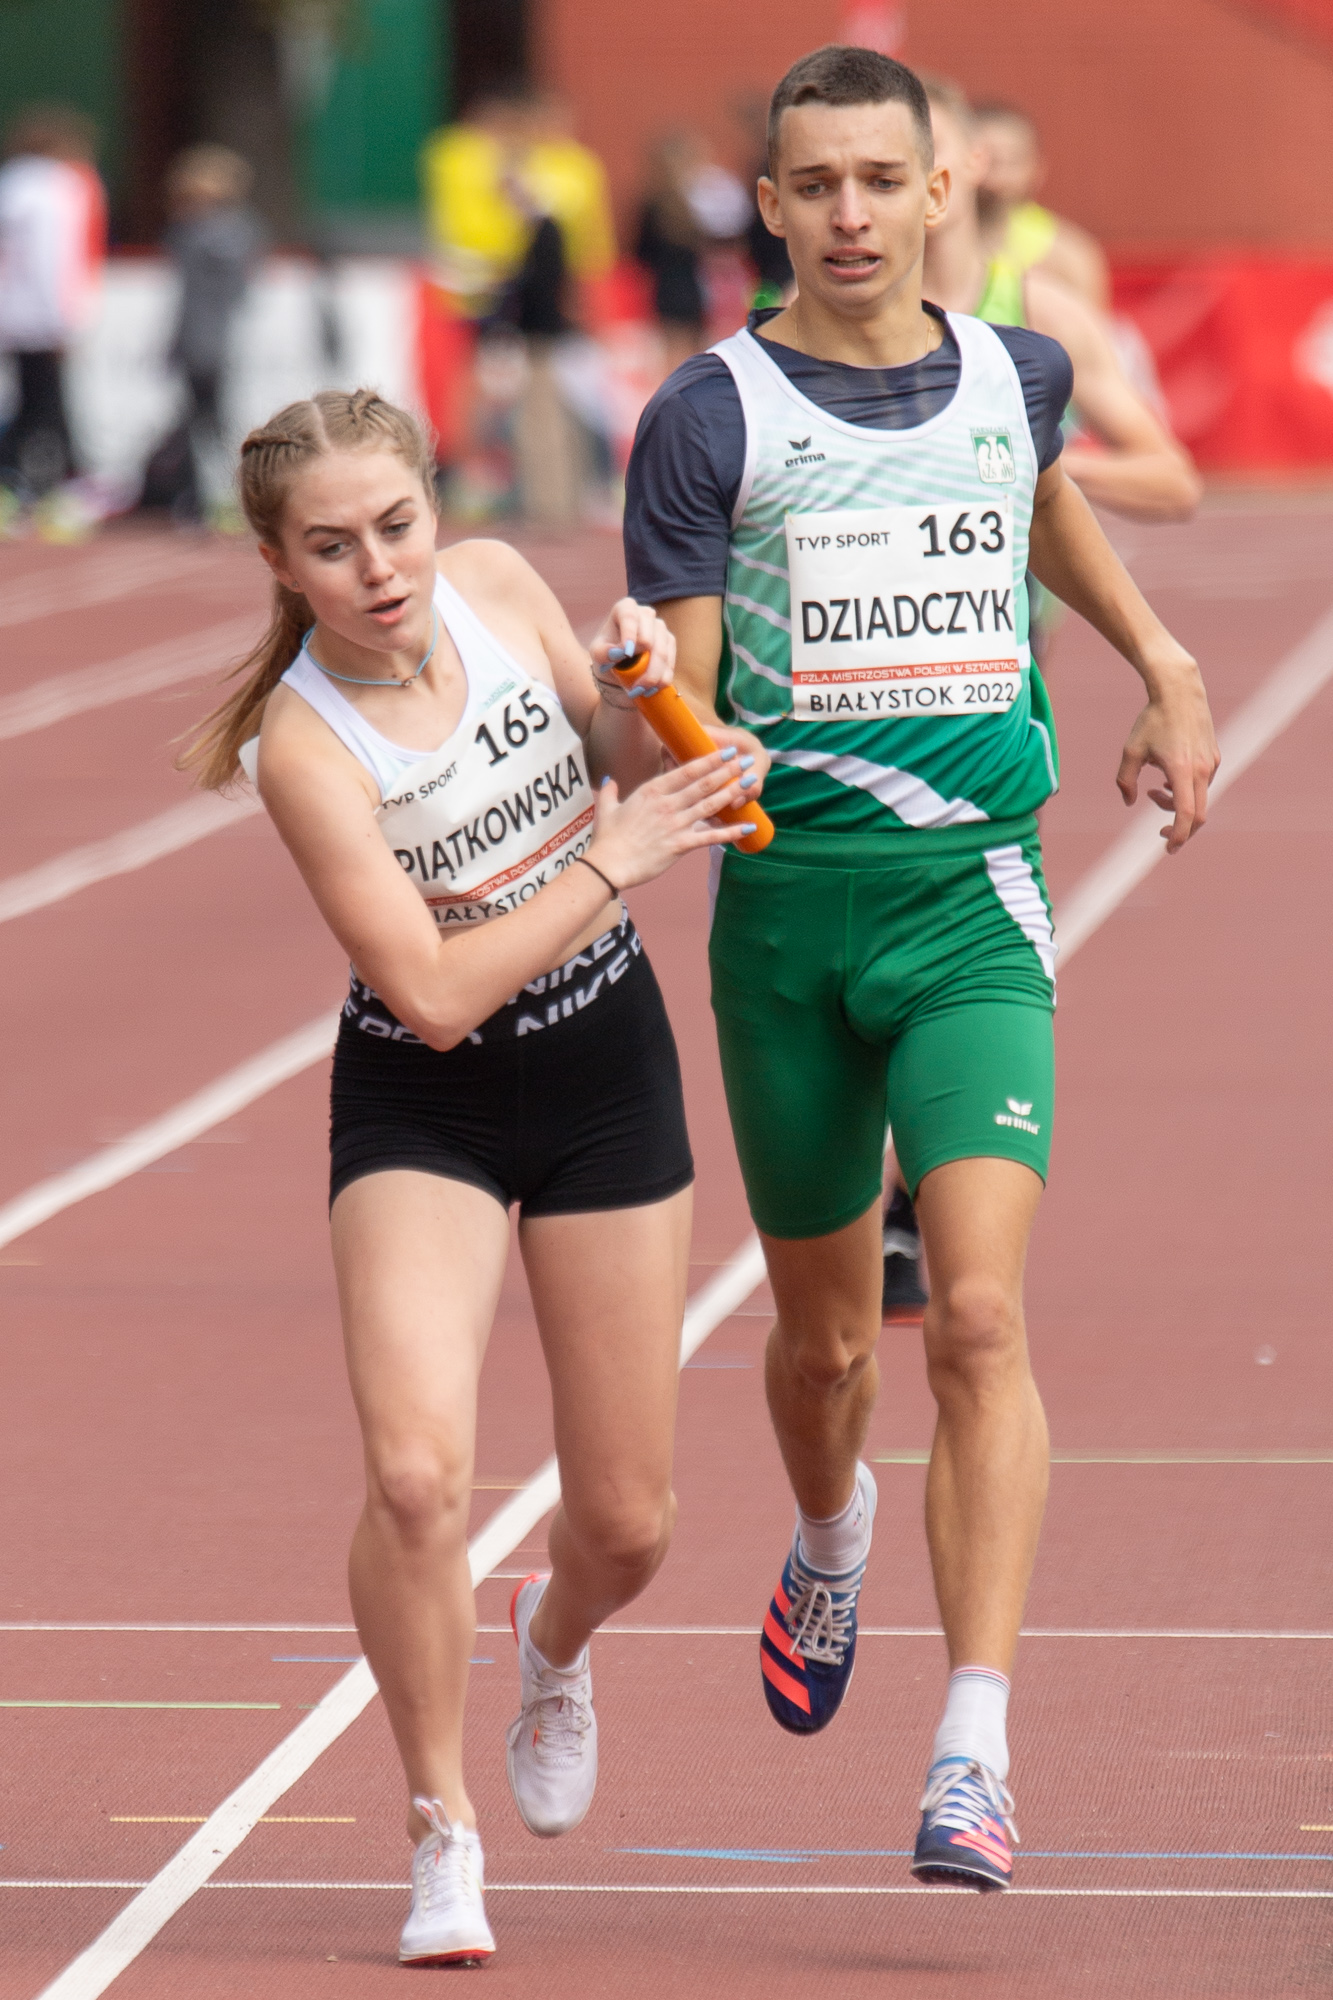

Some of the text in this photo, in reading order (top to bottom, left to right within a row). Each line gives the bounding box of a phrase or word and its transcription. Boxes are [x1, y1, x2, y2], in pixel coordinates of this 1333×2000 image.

[784, 452, 826, 468] erima
[795, 531, 891, 551] TVP SPORT
[918, 511, 1005, 558] 163
[801, 588, 1014, 644] DZIADCZYK
[800, 674, 829, 684] PZLA
[831, 668, 912, 682] MISTRZOSTWA
[914, 665, 951, 677] POLSKI
[952, 665, 963, 674] W
[810, 682, 1014, 712] BIAŁYSTOK 2022
[474, 689, 550, 768] 165
[418, 761, 458, 799] SPORT
[394, 754, 584, 882] PIĄTKOWSKA
[510, 854, 541, 878] POLSKI
[540, 846, 549, 856] W
[433, 870, 547, 923] IAŁYSTOK
